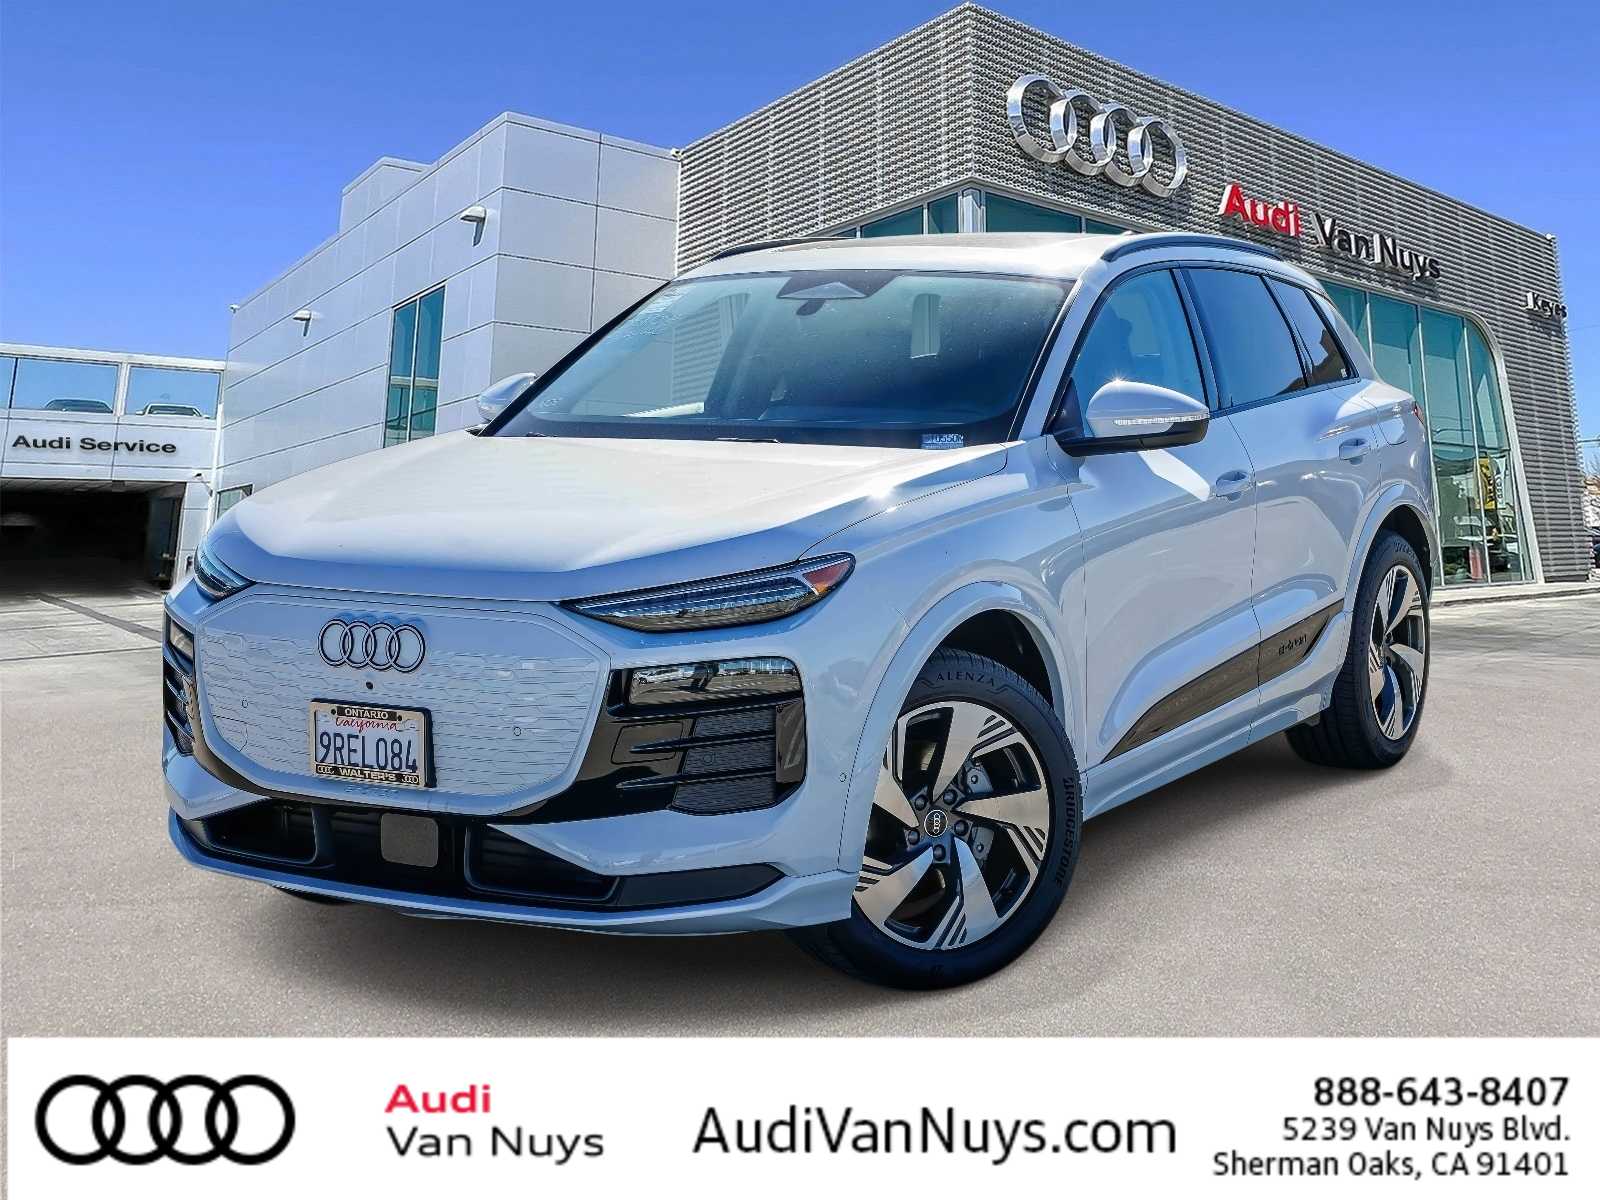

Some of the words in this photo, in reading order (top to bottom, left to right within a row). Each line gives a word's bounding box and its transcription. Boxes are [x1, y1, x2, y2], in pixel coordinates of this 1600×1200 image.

[1217, 182, 1303, 237] Audi
[1310, 211, 1370, 259] Van
[1371, 232, 1441, 281] Nuys
[12, 435, 71, 449] Audi
[80, 437, 177, 454] Service
[936, 671, 998, 688] ALENZA
[344, 707, 389, 720] ONTARIO
[336, 717, 398, 733] California
[319, 731, 418, 774] 9REL084
[339, 767, 397, 781] WALTER'S
